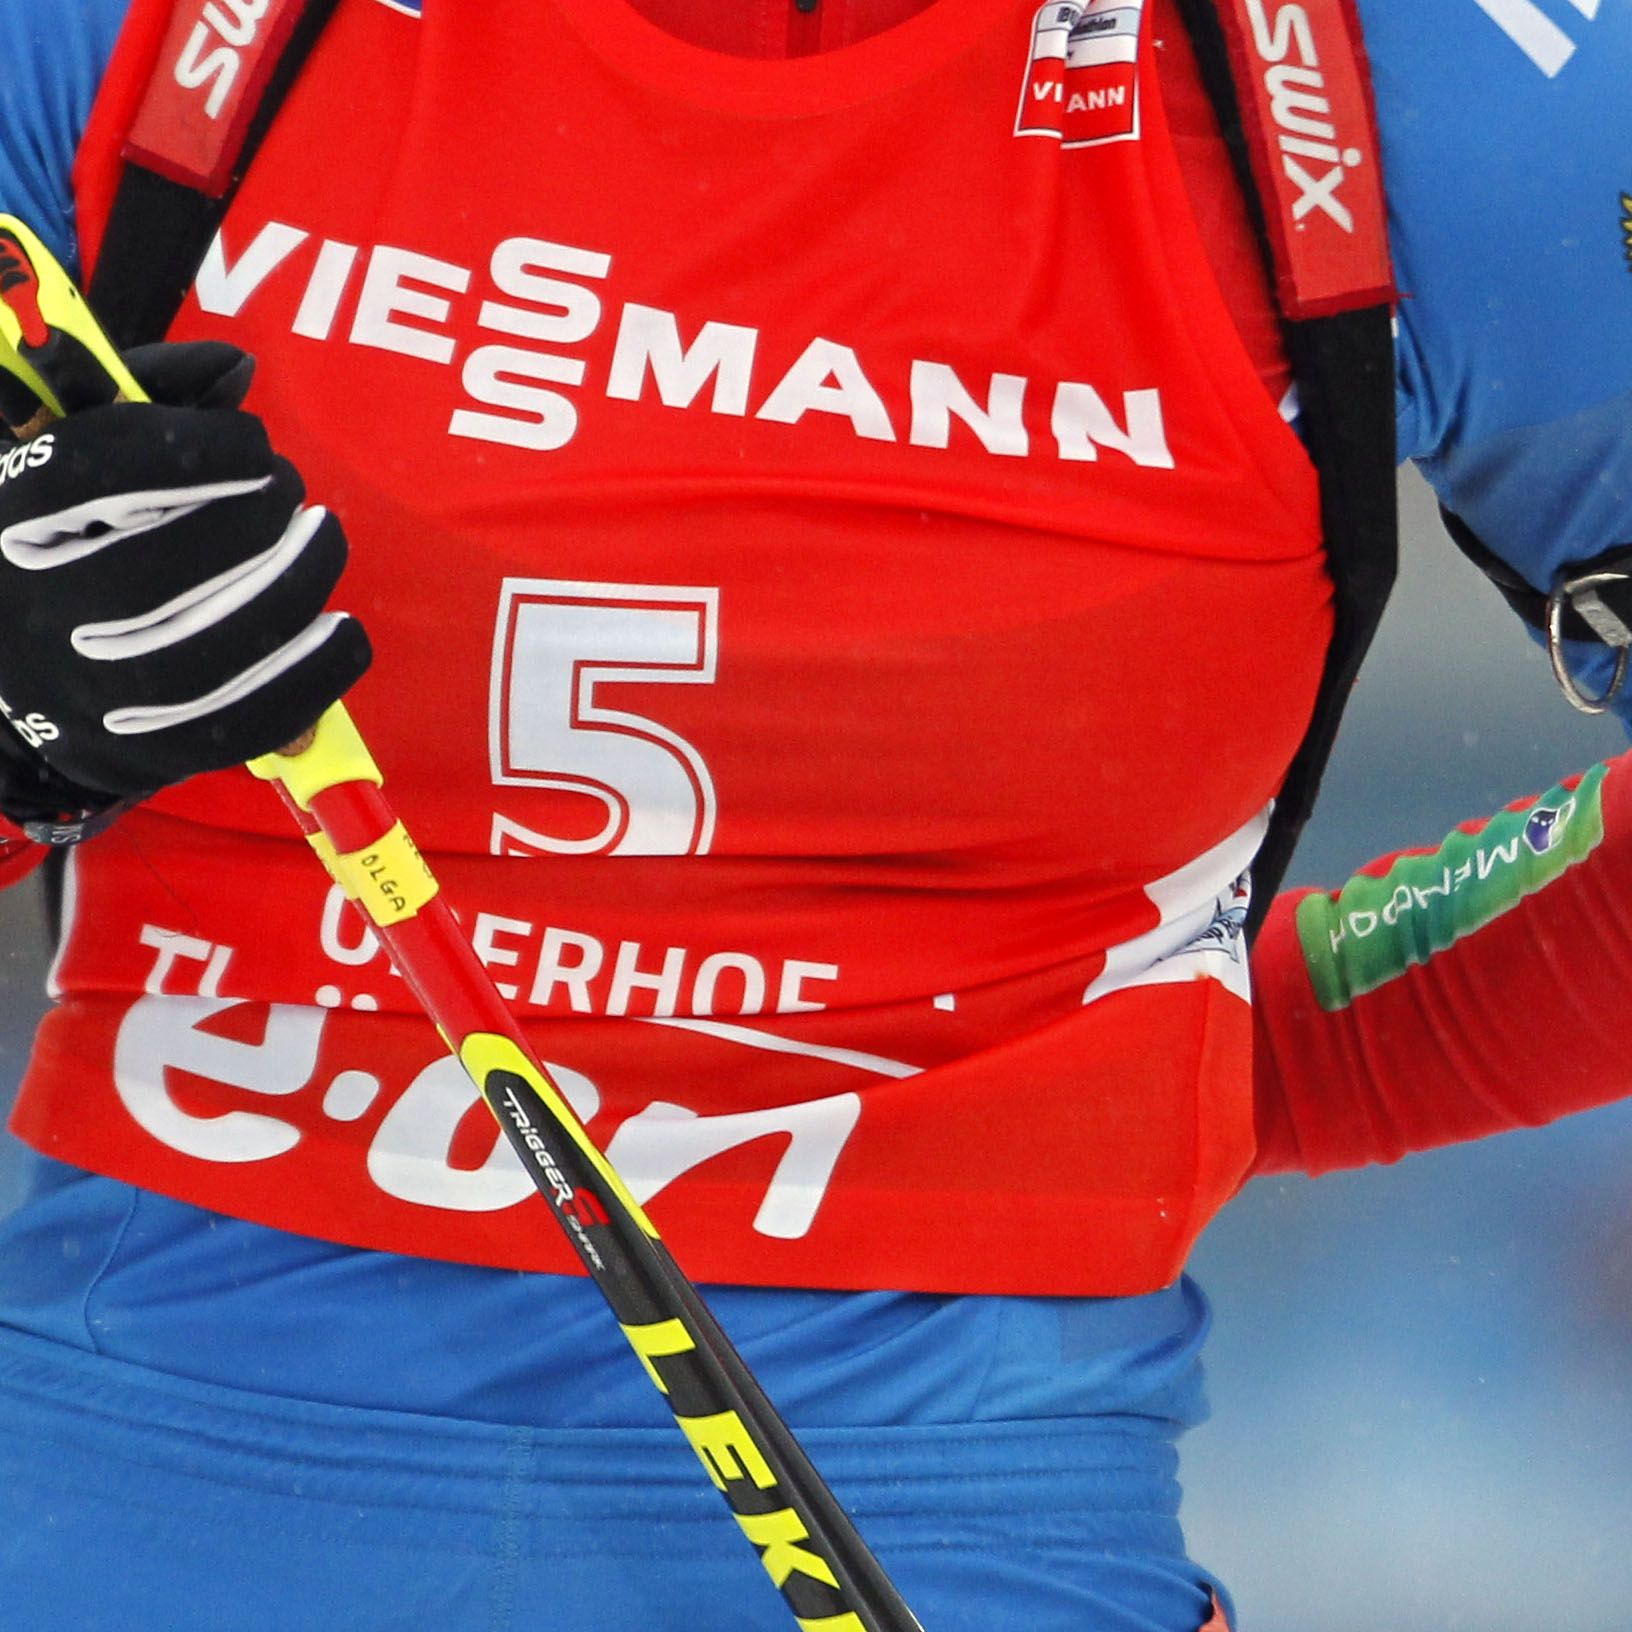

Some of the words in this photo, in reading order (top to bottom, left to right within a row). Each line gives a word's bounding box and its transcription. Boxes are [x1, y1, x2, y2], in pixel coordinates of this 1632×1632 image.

[195, 220, 1175, 469] VIESSMANN
[488, 576, 720, 857] 5
[320, 882, 839, 1017] OERHOF
[361, 854, 407, 912] OLGA
